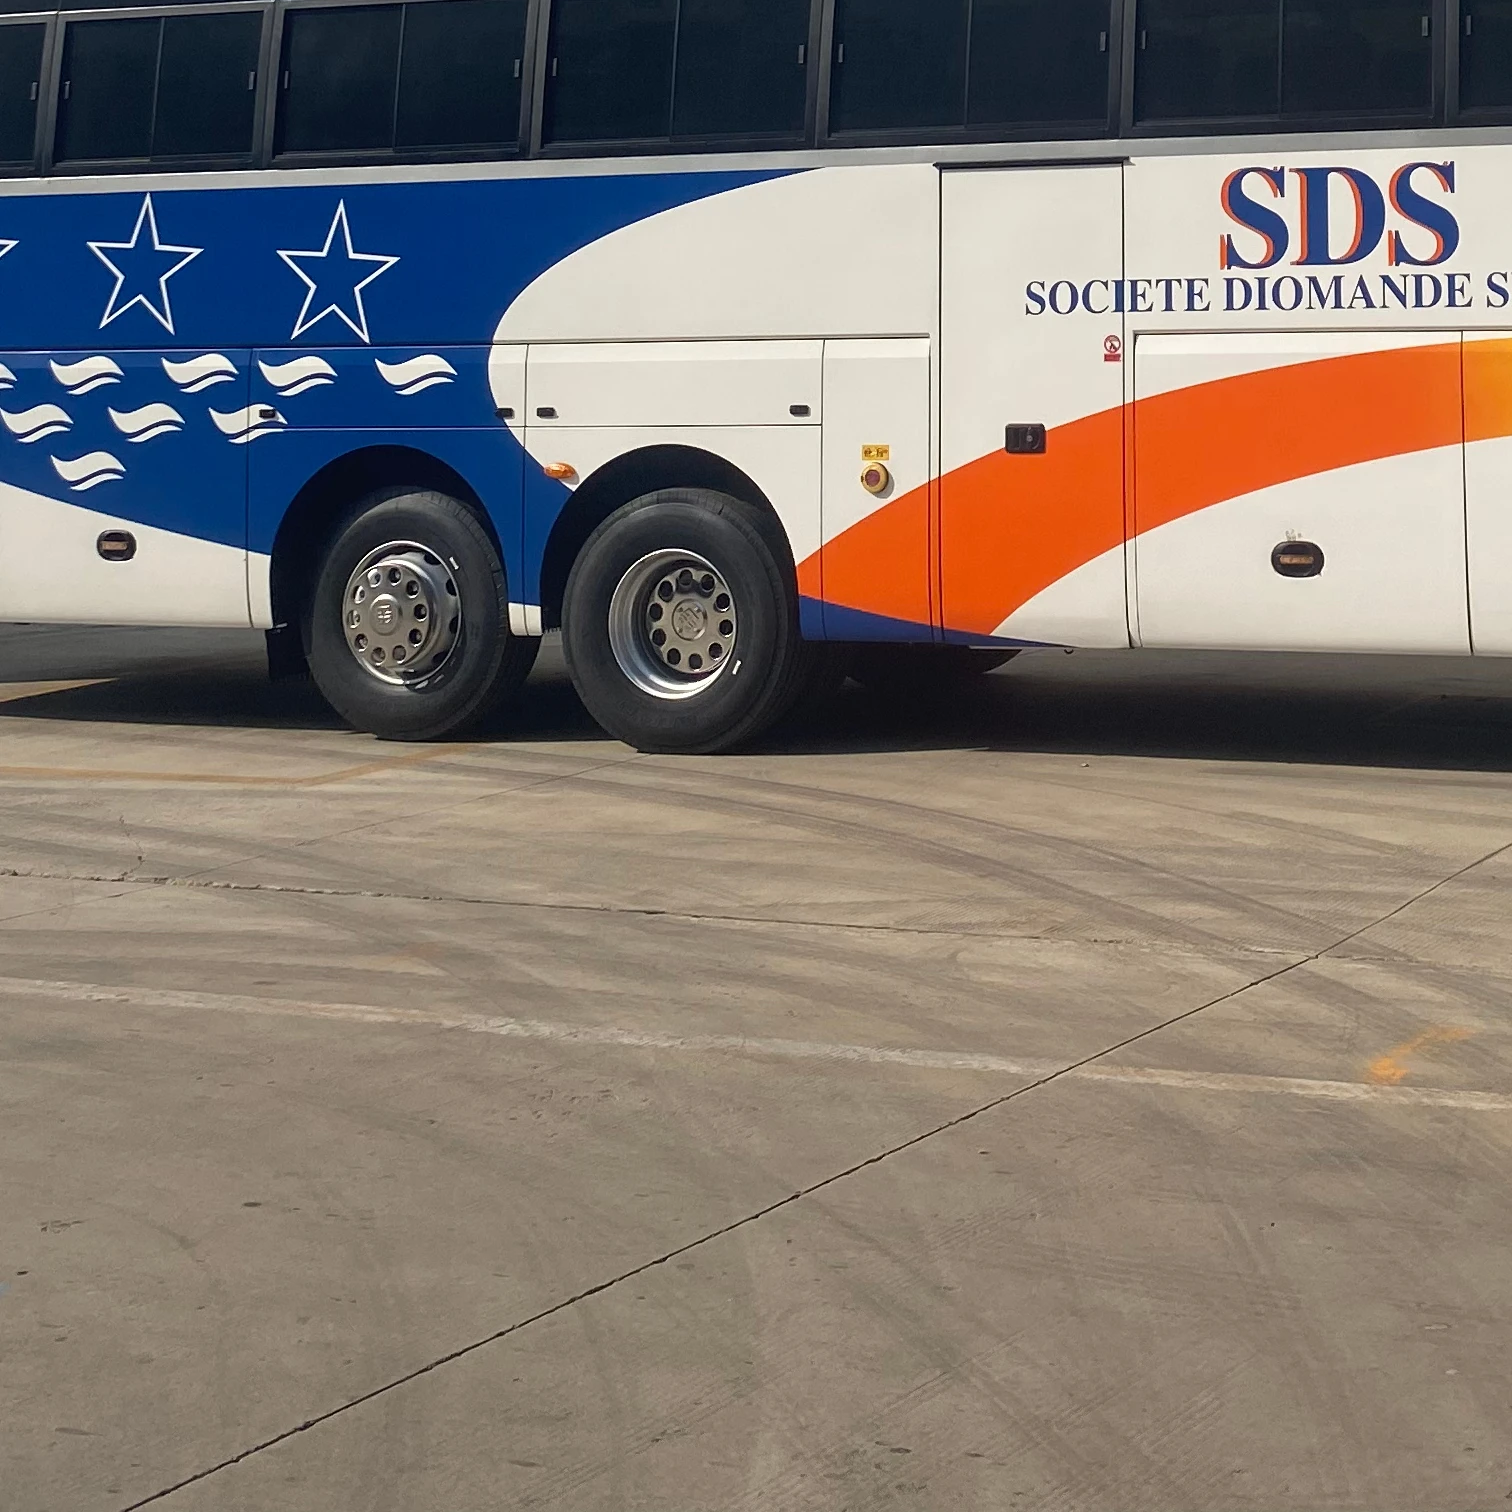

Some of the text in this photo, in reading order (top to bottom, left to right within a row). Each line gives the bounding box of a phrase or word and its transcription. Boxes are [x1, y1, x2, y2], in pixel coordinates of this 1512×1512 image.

[1220, 161, 1460, 270] SDS
[1025, 279, 1211, 316] SOCIETE
[1223, 272, 1472, 311] DIOMANDE
